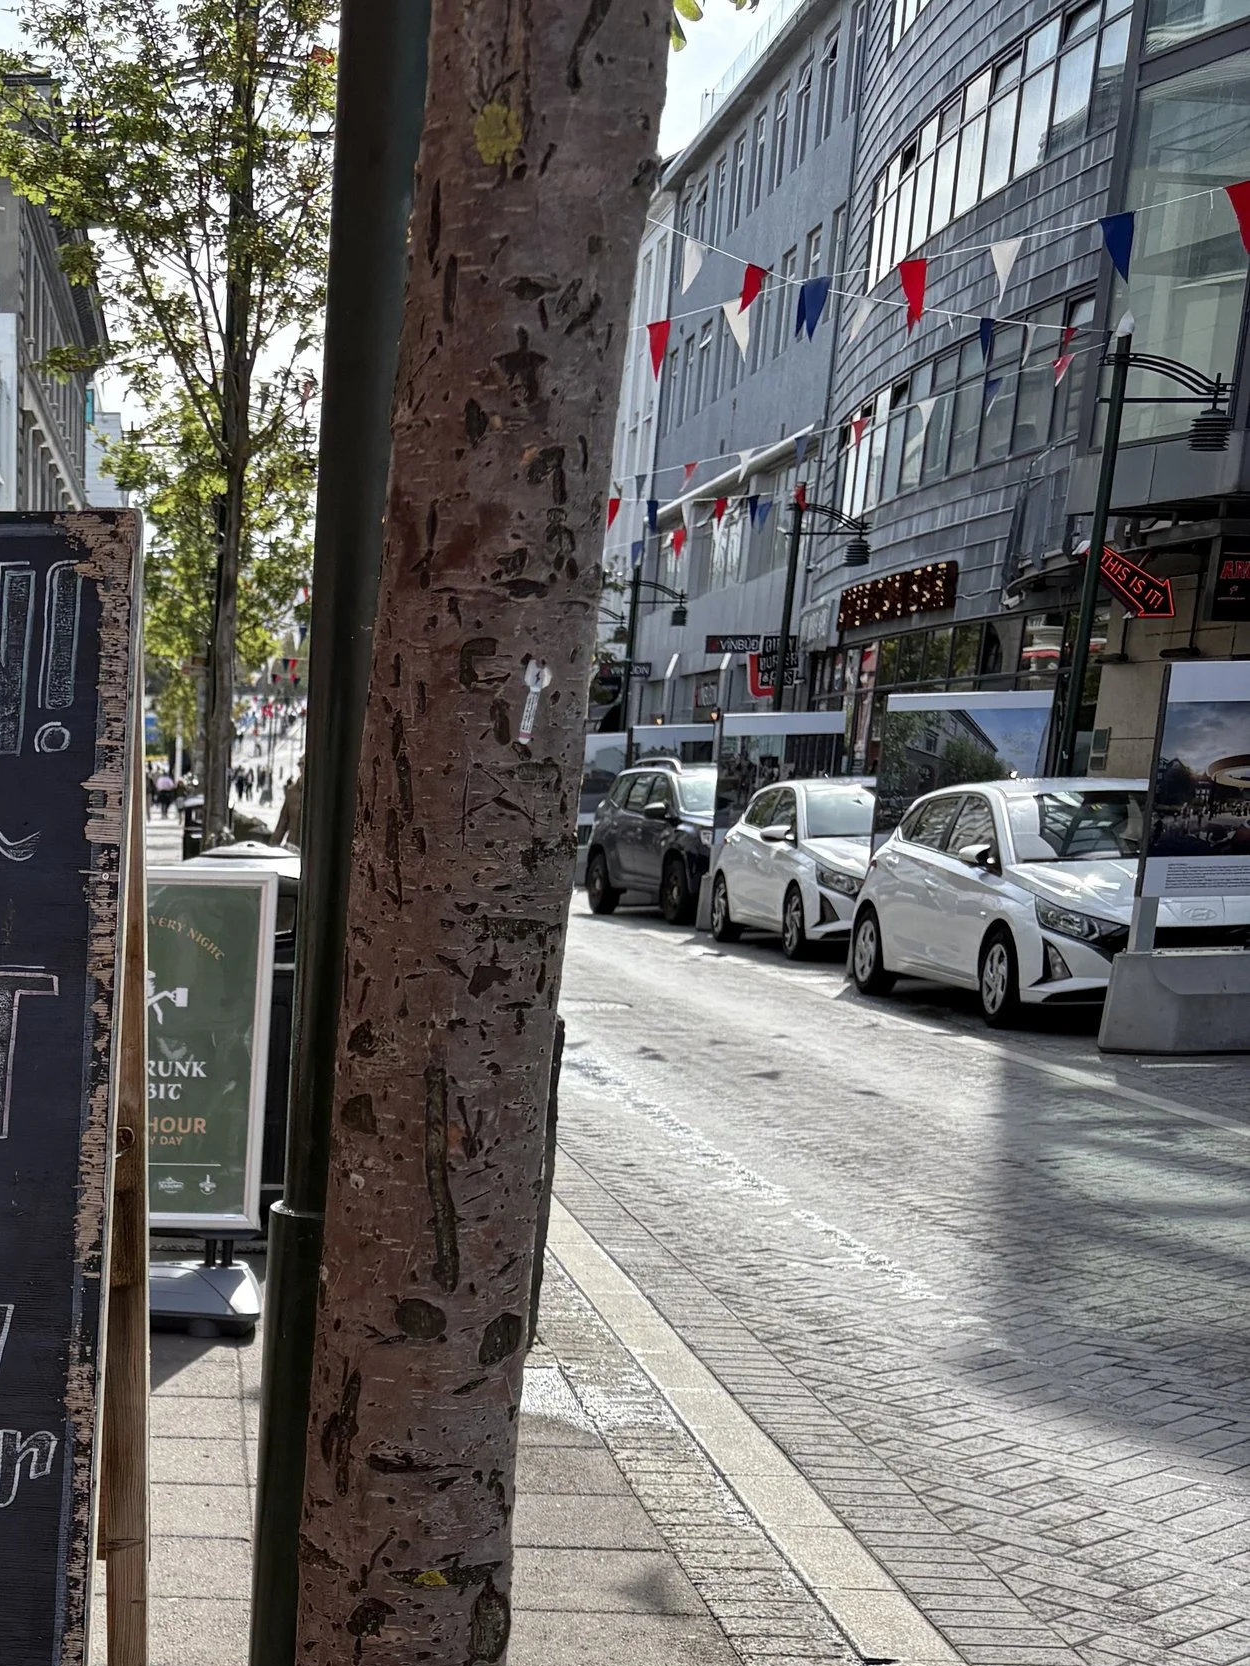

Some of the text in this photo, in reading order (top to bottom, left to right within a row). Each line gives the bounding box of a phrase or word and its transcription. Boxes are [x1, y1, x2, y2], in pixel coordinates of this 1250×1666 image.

[1100, 550, 1164, 609] THIS IS IT!
[150, 915, 225, 961] VERY NIGHT
[148, 1061, 207, 1078] RUNK
[148, 1083, 182, 1100] BIT
[160, 1136, 183, 1146] DAY
